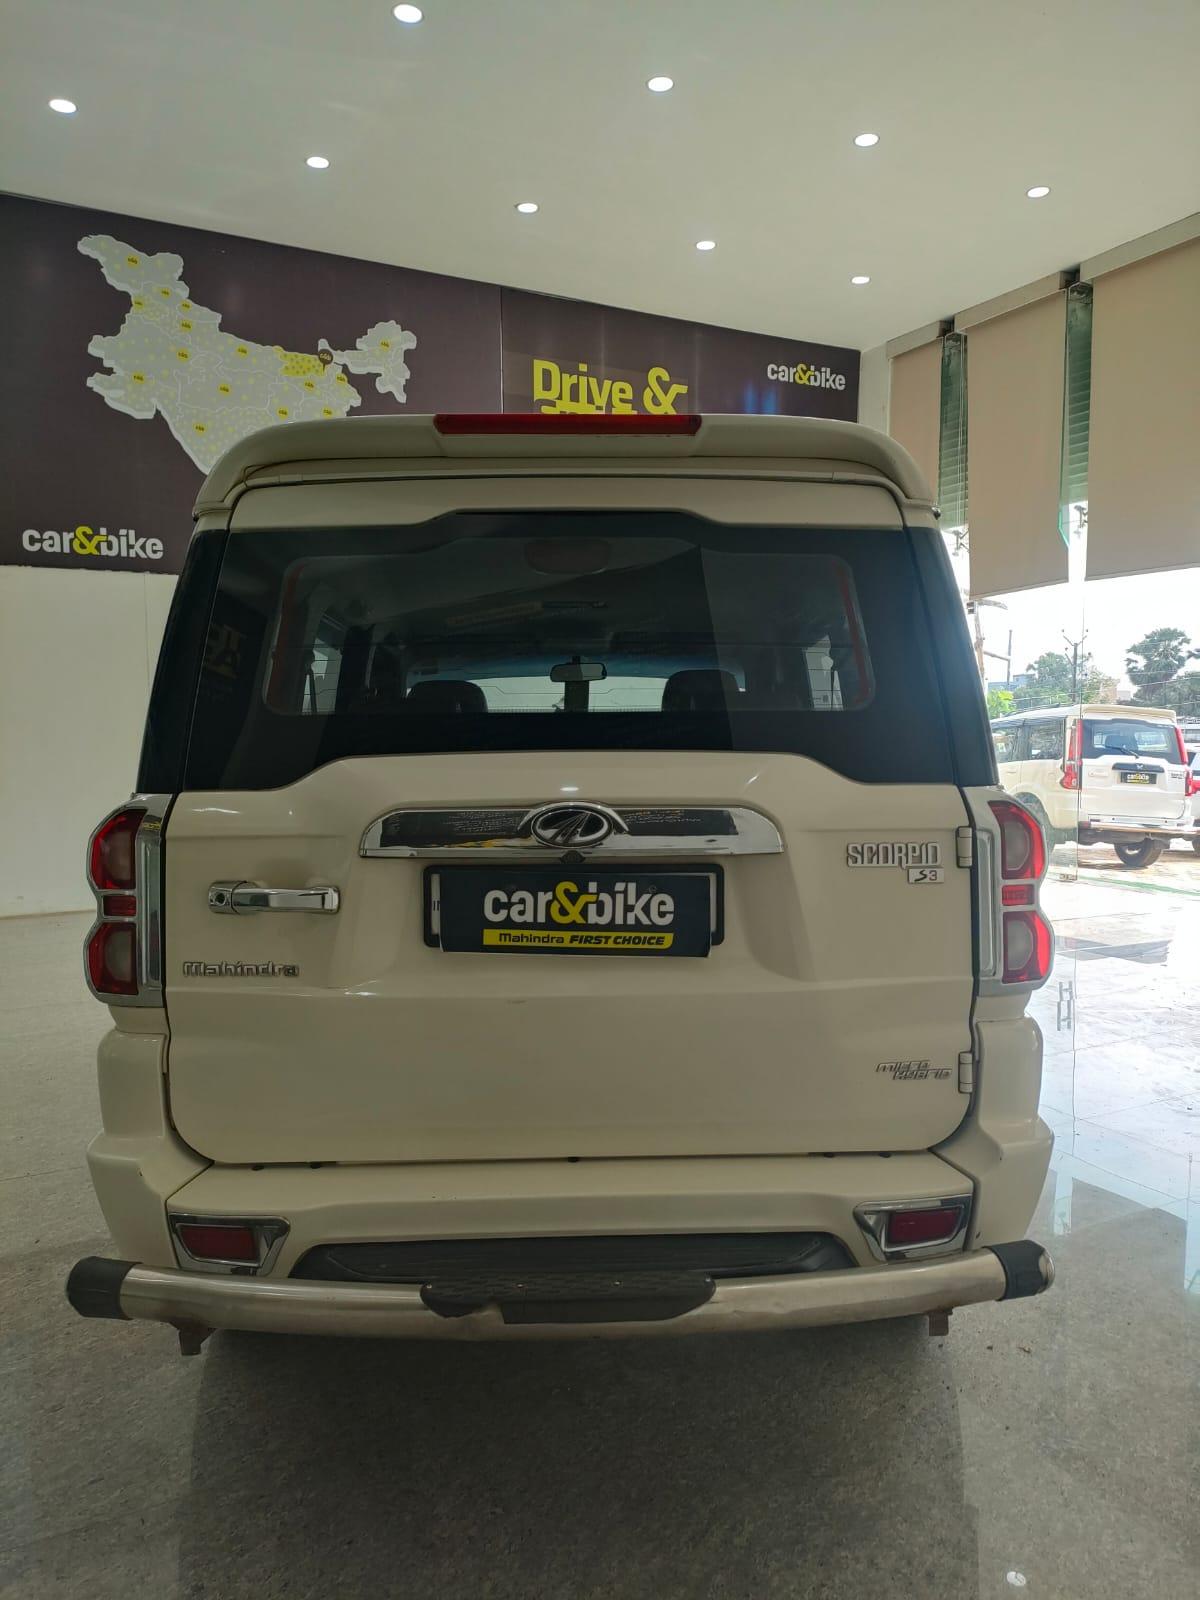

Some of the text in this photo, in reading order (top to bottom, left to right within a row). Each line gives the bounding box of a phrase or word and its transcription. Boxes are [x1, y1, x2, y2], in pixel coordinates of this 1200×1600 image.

[533, 359, 688, 414] Drive &
[767, 363, 846, 391] car&bike
[22, 526, 164, 560] car&bike
[483, 881, 675, 926] car&bike
[499, 932, 665, 946] Mahindra FIRST CHOICE
[183, 961, 299, 977] Mahindra
